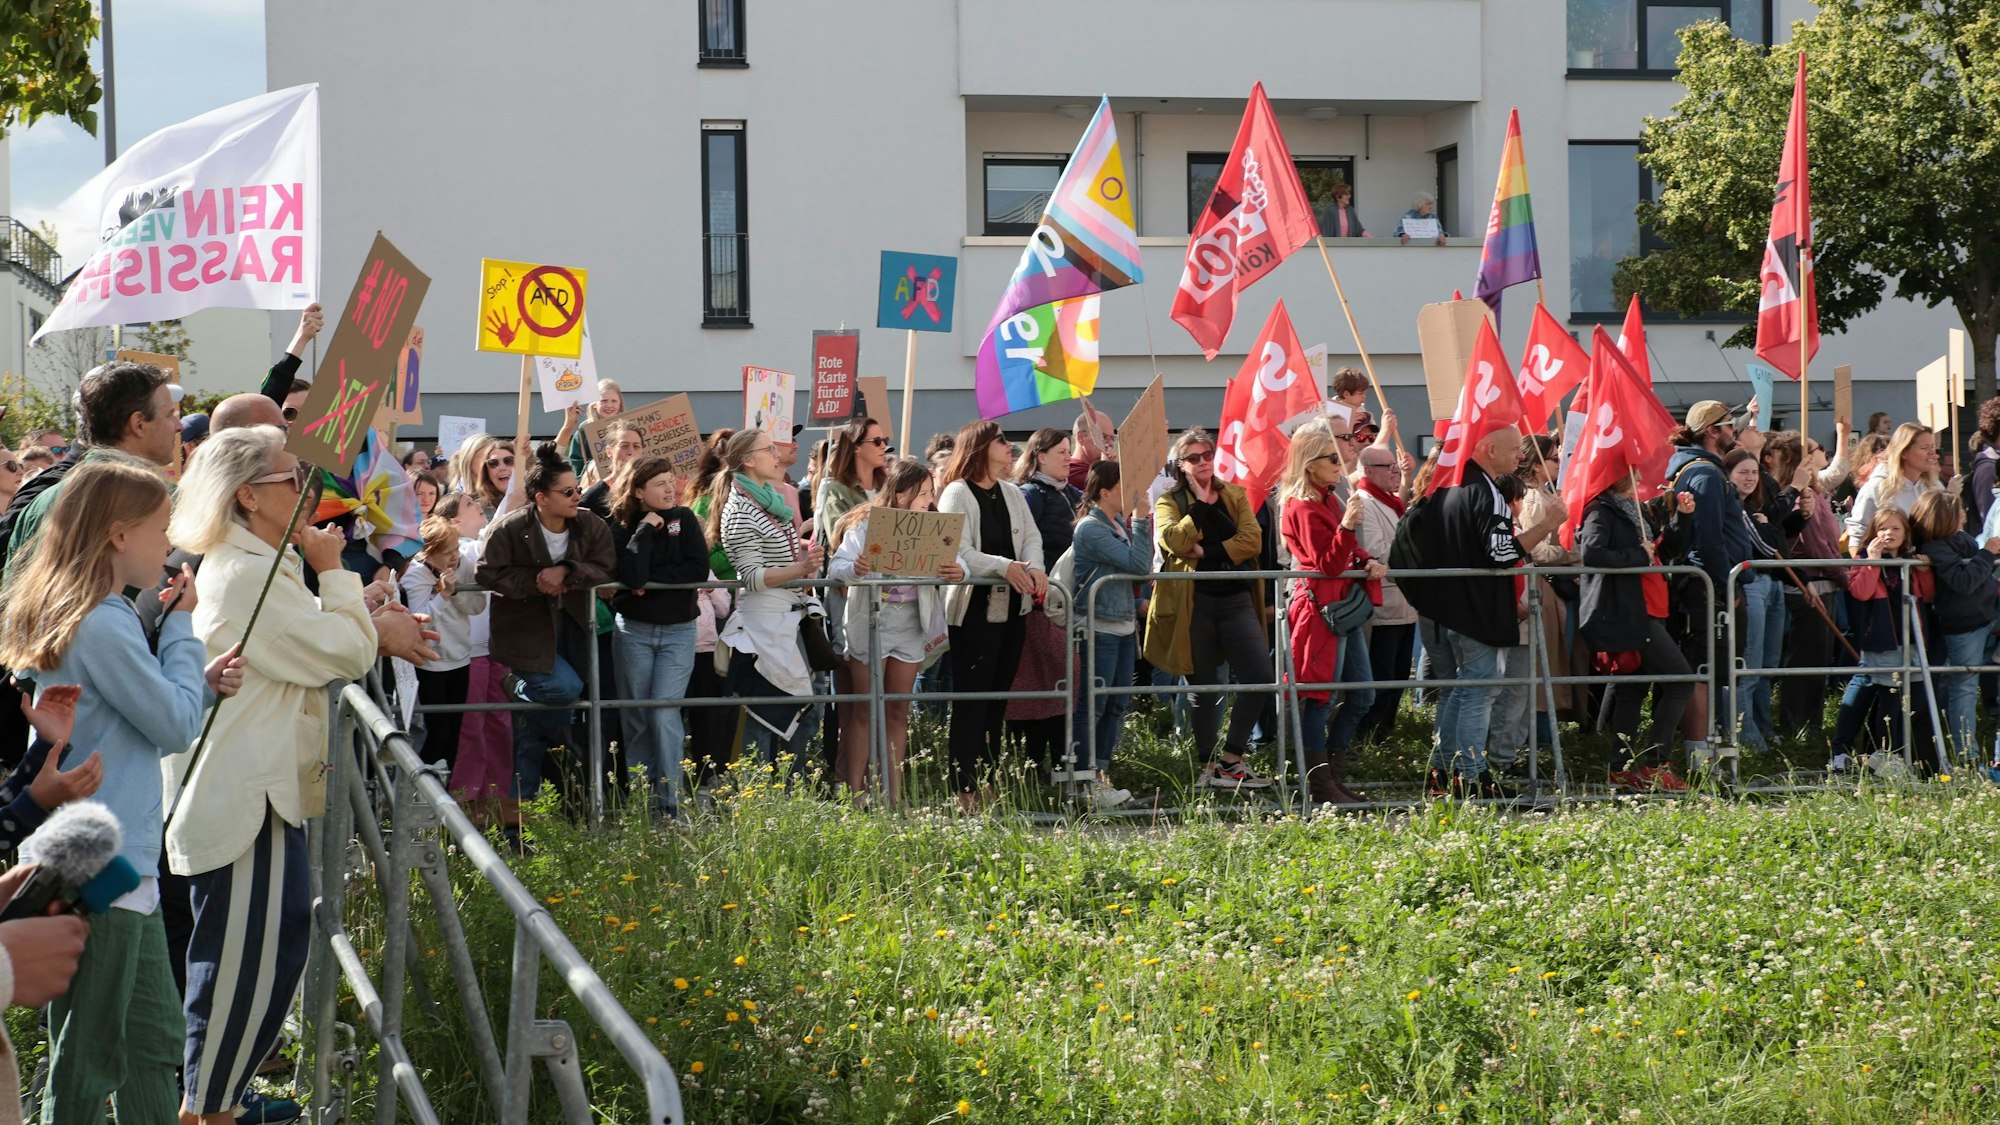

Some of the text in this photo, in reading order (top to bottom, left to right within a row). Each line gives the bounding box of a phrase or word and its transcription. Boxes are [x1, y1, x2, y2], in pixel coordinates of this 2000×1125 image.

[487, 267, 516, 300] Stop!
[894, 276, 940, 302] AFD
[352, 258, 409, 349] #NO
[530, 287, 569, 308] AFD
[818, 356, 843, 369] Rote
[818, 371, 847, 384] Karte
[817, 385, 849, 399] für die
[816, 400, 840, 414] AfD!
[893, 511, 947, 536] KÖLN
[897, 537, 921, 551] IST
[883, 551, 940, 572] BUNT
